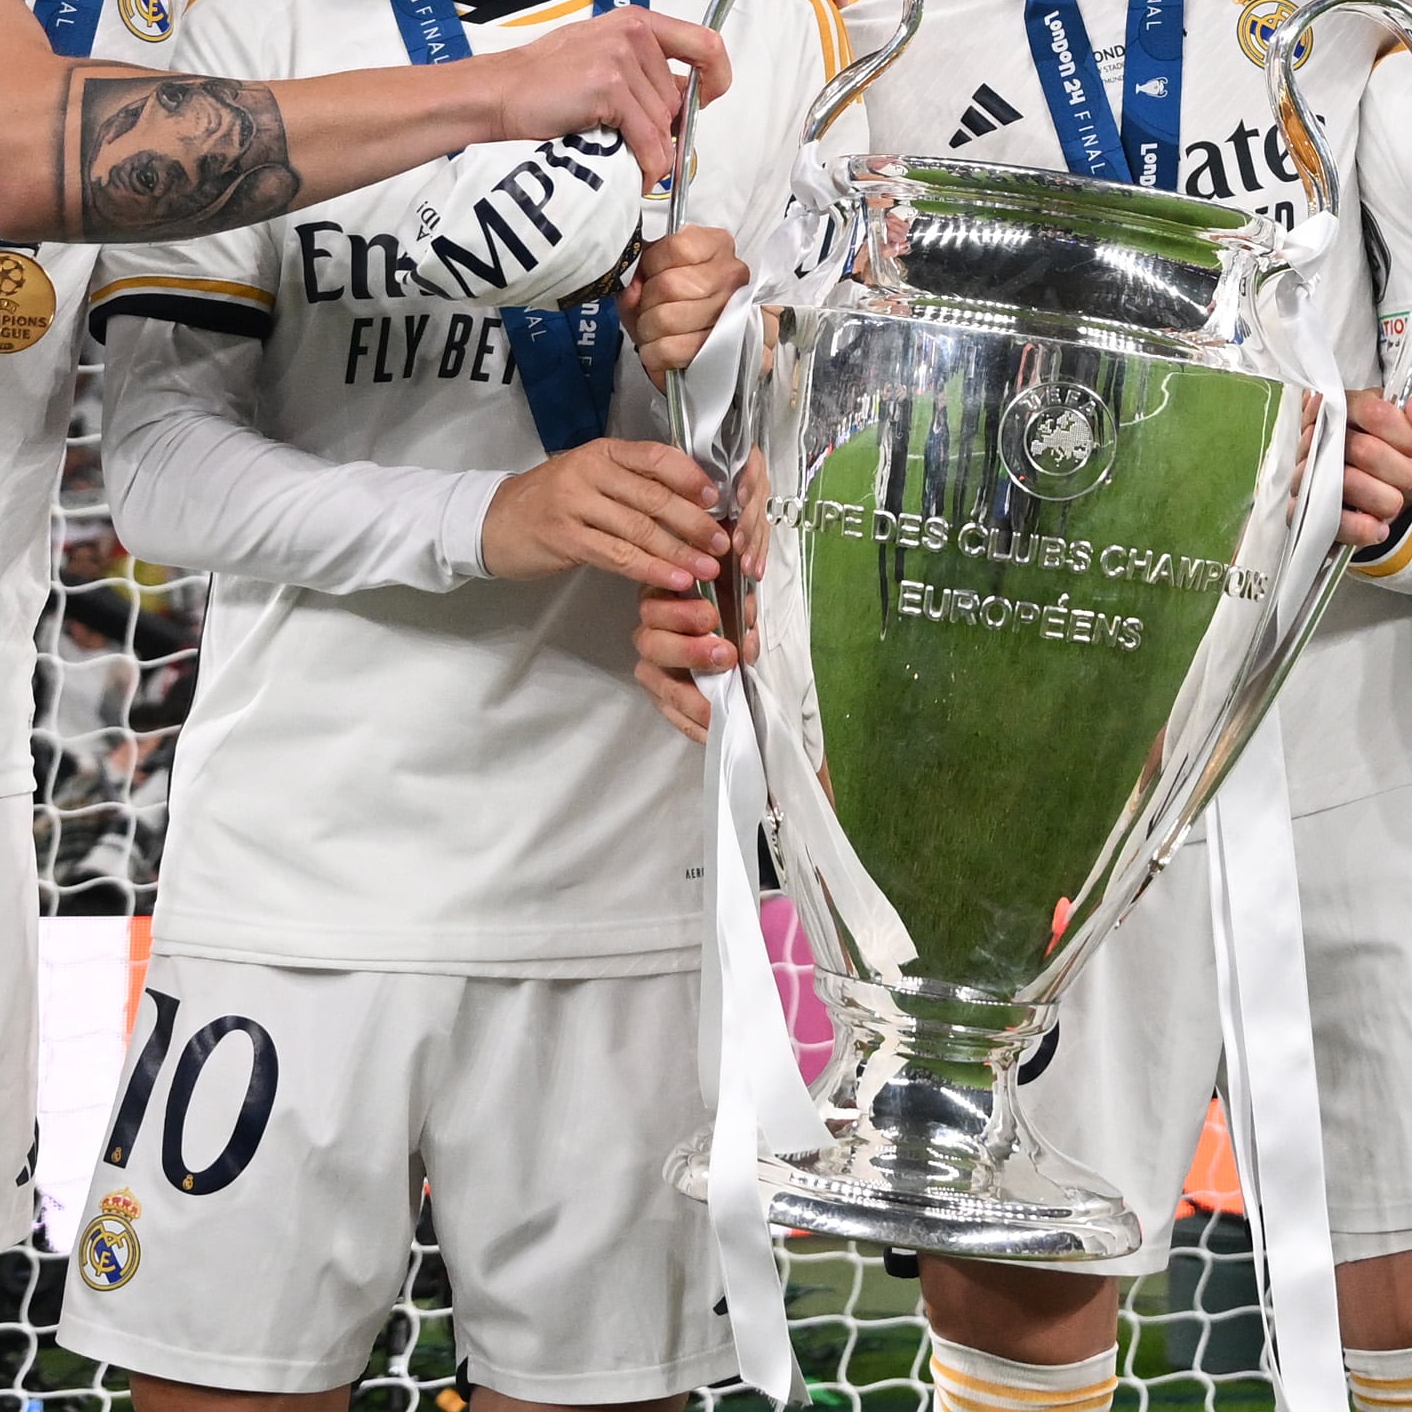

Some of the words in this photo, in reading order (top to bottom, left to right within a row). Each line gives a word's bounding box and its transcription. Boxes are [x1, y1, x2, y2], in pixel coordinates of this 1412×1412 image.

[415, 5, 450, 65] FINAL
[1093, 44, 1125, 63] OND
[1063, 78, 1087, 106] 24
[1074, 110, 1107, 176] FINAL
[1139, 142, 1158, 188] LonD
[344, 314, 430, 385] FLY
[576, 319, 597, 346] 24
[766, 496, 865, 539] COUPE
[871, 509, 950, 553] DES
[957, 521, 1094, 574] CLUBS
[1100, 544, 1270, 602] CHAMPIONS
[898, 579, 1144, 652] EUROPÉENS
[102, 986, 279, 1196] 10
